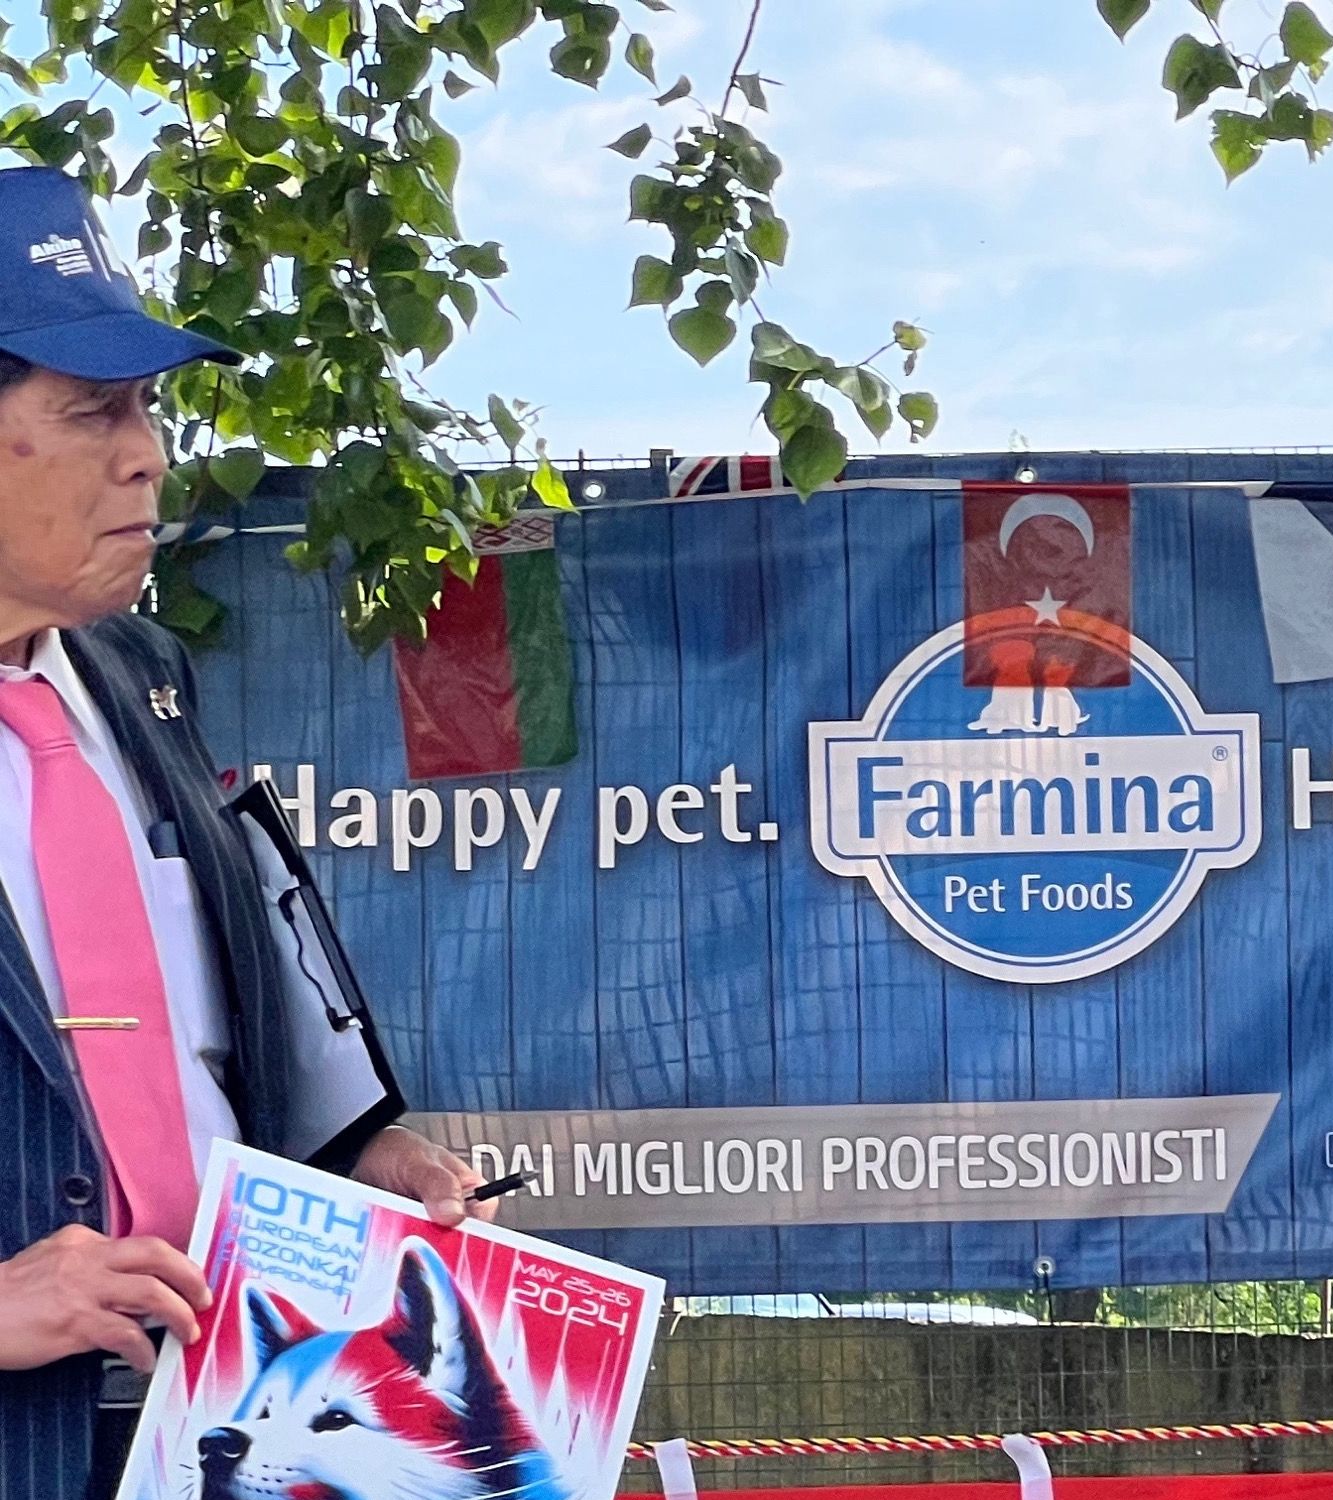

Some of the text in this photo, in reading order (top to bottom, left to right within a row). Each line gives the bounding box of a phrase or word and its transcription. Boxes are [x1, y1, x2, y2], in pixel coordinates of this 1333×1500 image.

[598, 763, 779, 869] pet.
[856, 753, 1214, 839] Farmina
[943, 873, 1134, 913] Pet Foods
[470, 1127, 1226, 1197] DAI MIGLIORI PROFESSIONISTI
[516, 1258, 562, 1283] MAY
[510, 1280, 629, 1336] 2024
